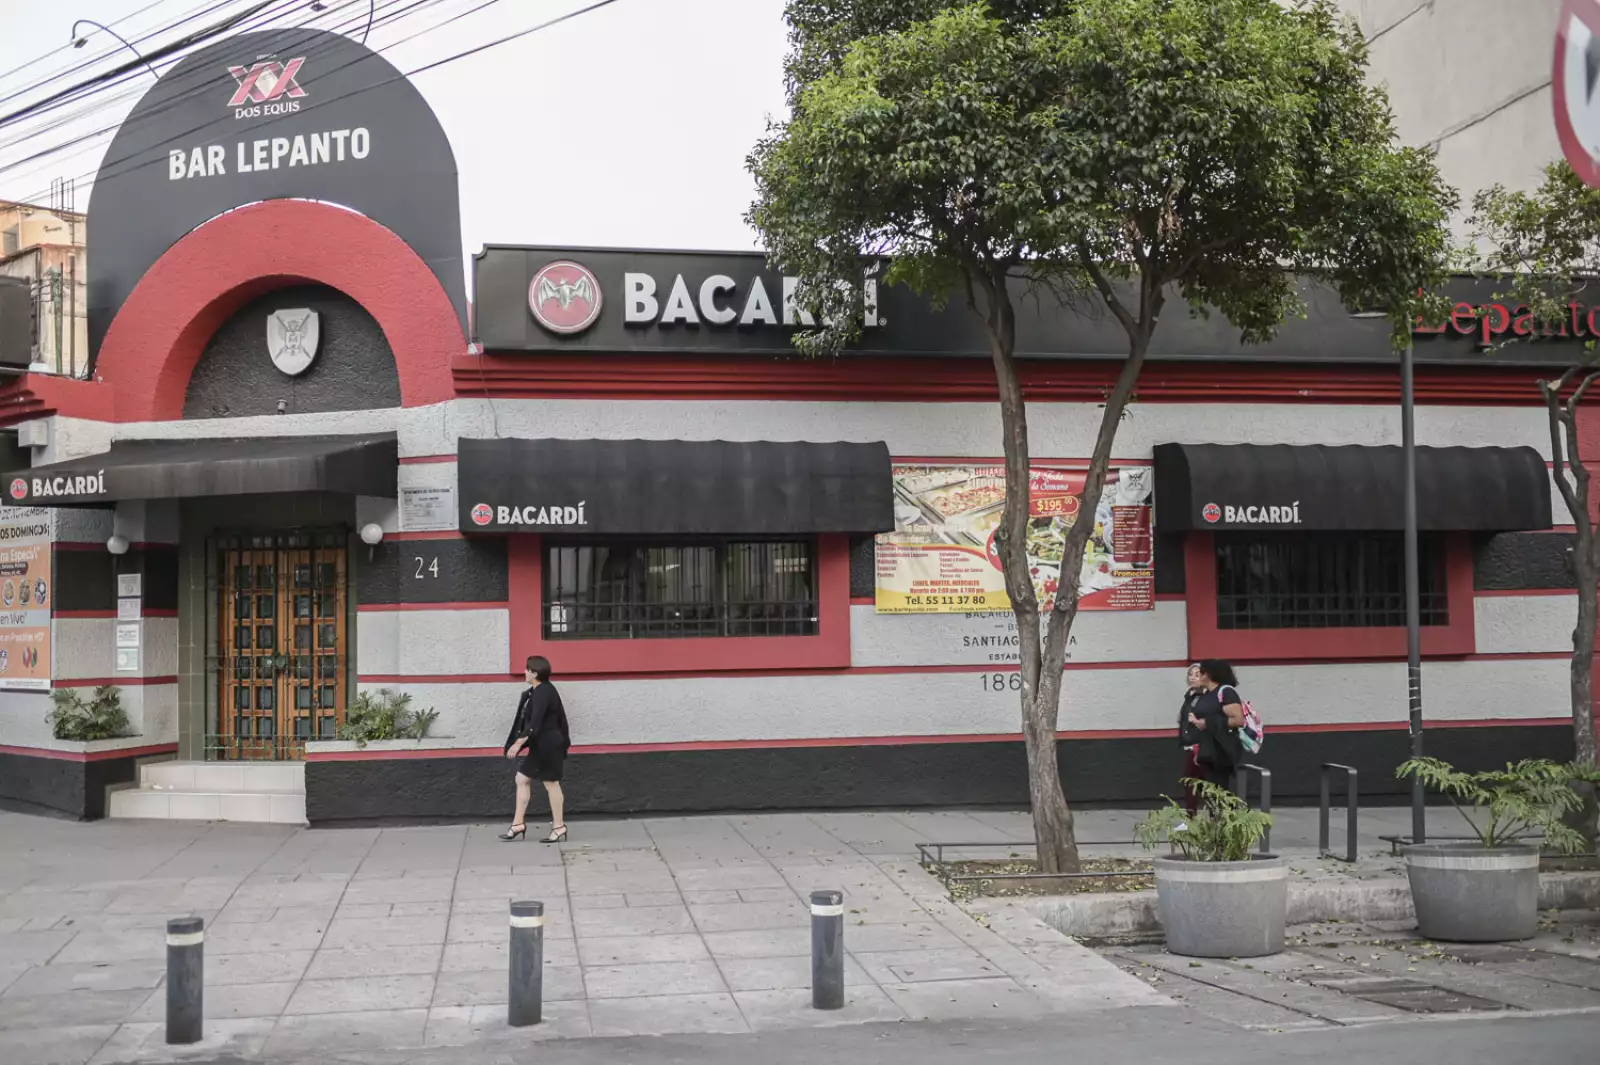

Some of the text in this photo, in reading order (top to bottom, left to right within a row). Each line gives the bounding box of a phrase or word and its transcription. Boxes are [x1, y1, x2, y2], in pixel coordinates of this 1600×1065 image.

[235, 100, 300, 119] DOS EQUIS
[169, 127, 370, 180] BAR LEPANTO
[32, 469, 106, 497] BACARDÍ
[497, 500, 587, 525] BACARDÍ
[1224, 500, 1302, 523] BACARDÍ
[415, 556, 438, 579] 24
[1113, 569, 1151, 577] Promoción
[905, 596, 985, 605] Tel. 55 11 37 80
[963, 635, 1019, 647] SANTIAG
[980, 672, 1021, 691] 186
